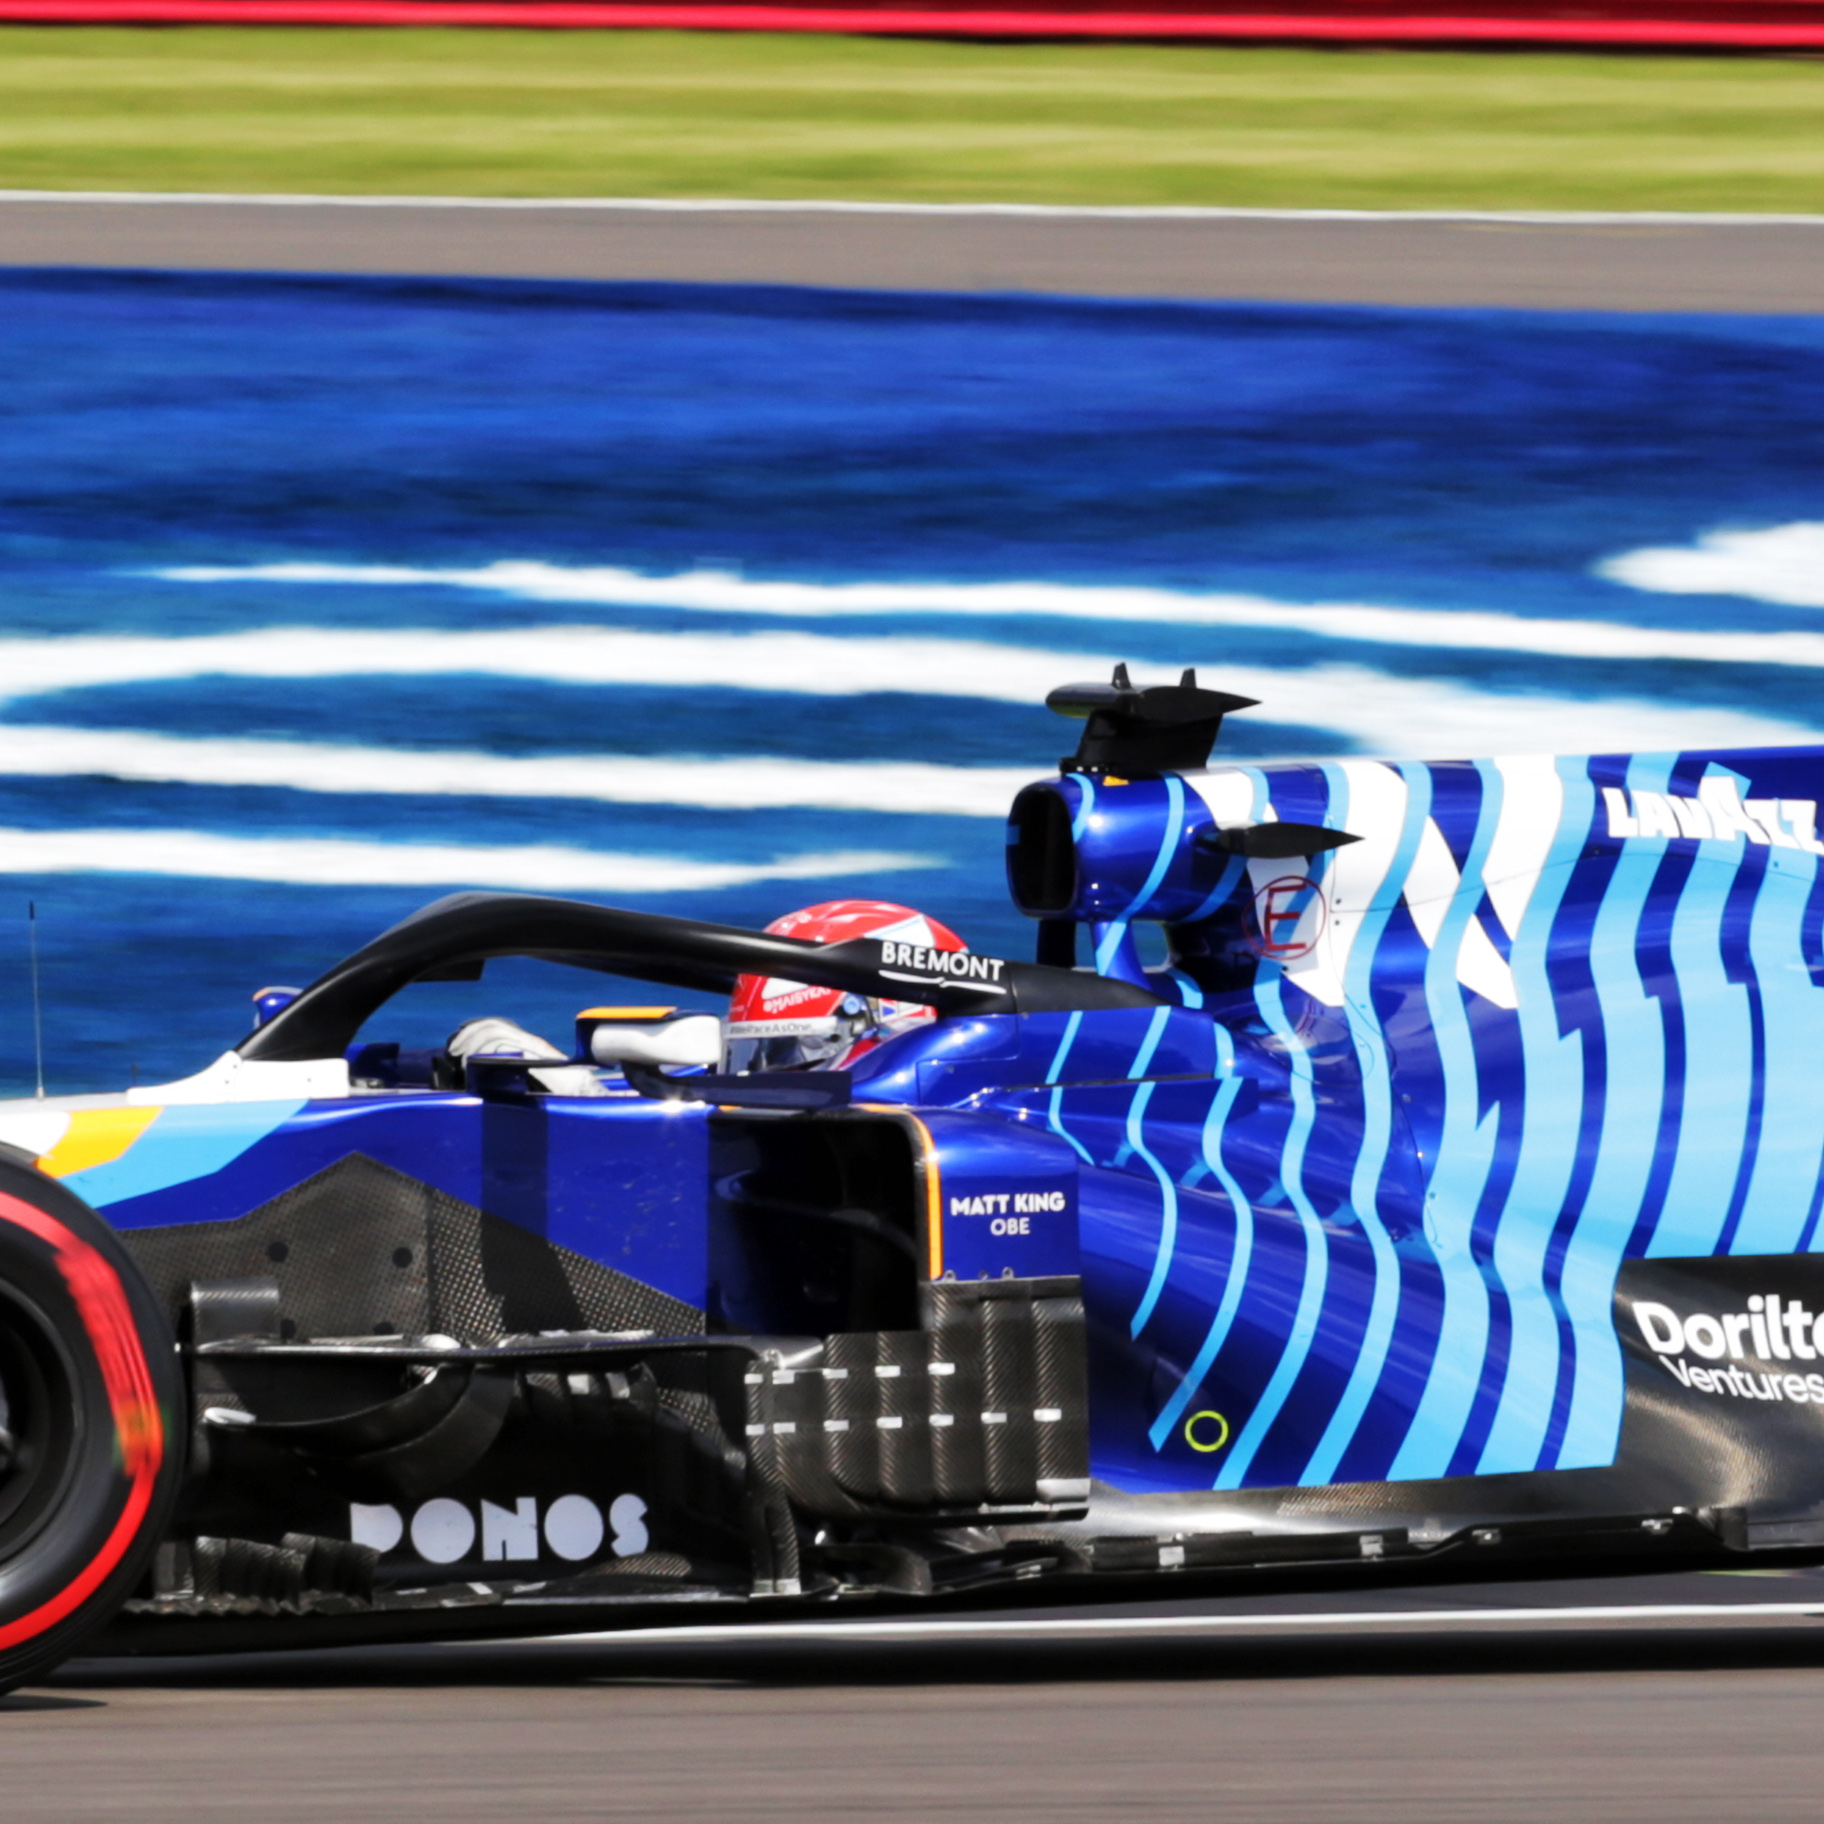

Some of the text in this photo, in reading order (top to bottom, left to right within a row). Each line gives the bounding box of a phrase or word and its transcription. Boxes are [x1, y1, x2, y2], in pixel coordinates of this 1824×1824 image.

[1263, 882, 1308, 952] E
[881, 940, 1005, 982] BREMONT
[950, 1191, 1066, 1216] MATT KING
[989, 1217, 1031, 1236] OBE
